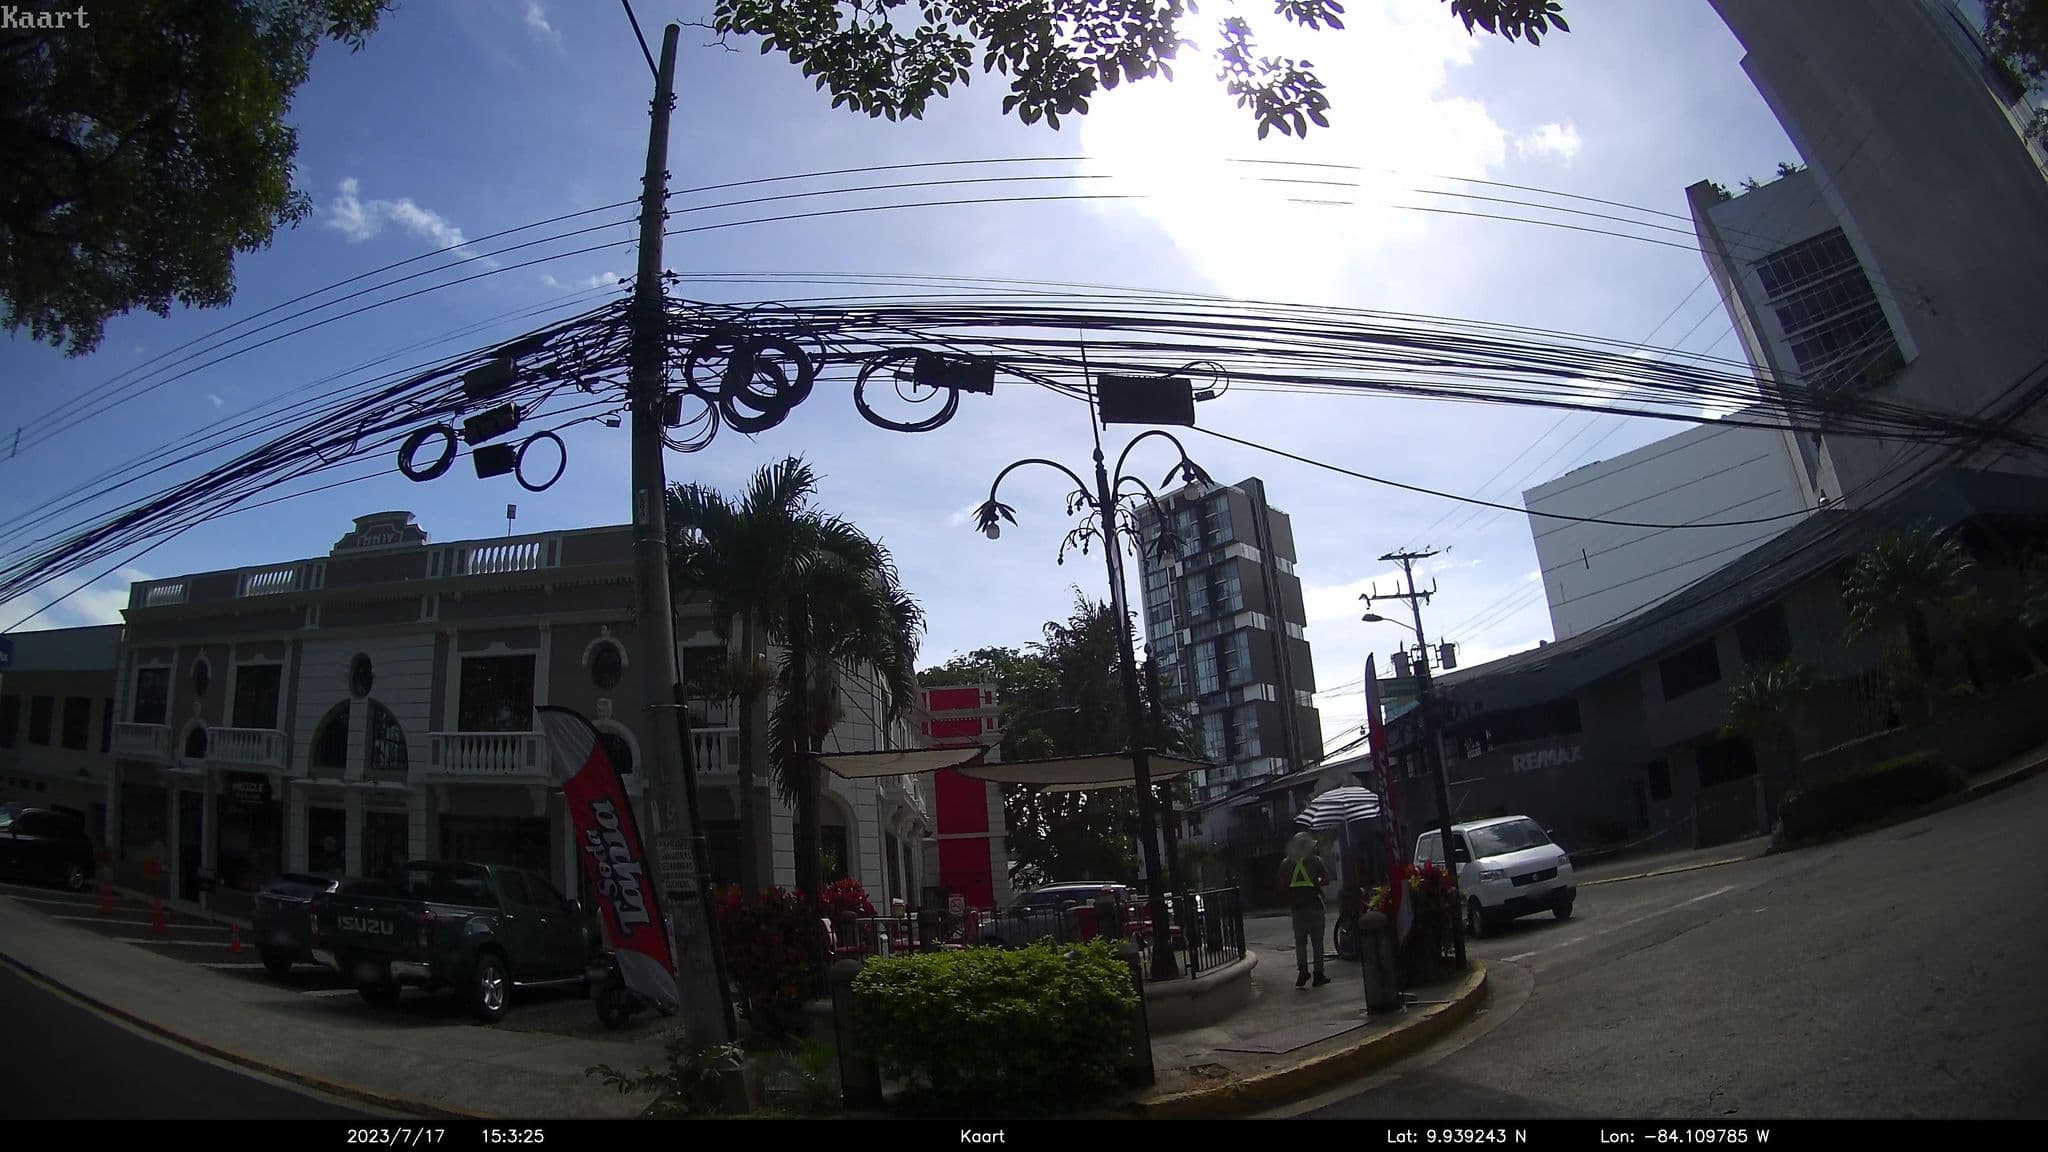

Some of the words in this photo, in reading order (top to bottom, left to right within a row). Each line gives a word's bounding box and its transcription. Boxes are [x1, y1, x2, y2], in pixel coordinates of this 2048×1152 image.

[585, 829, 619, 898] Soda
[592, 800, 649, 936] Tapia
[337, 915, 394, 935] ISUZU
